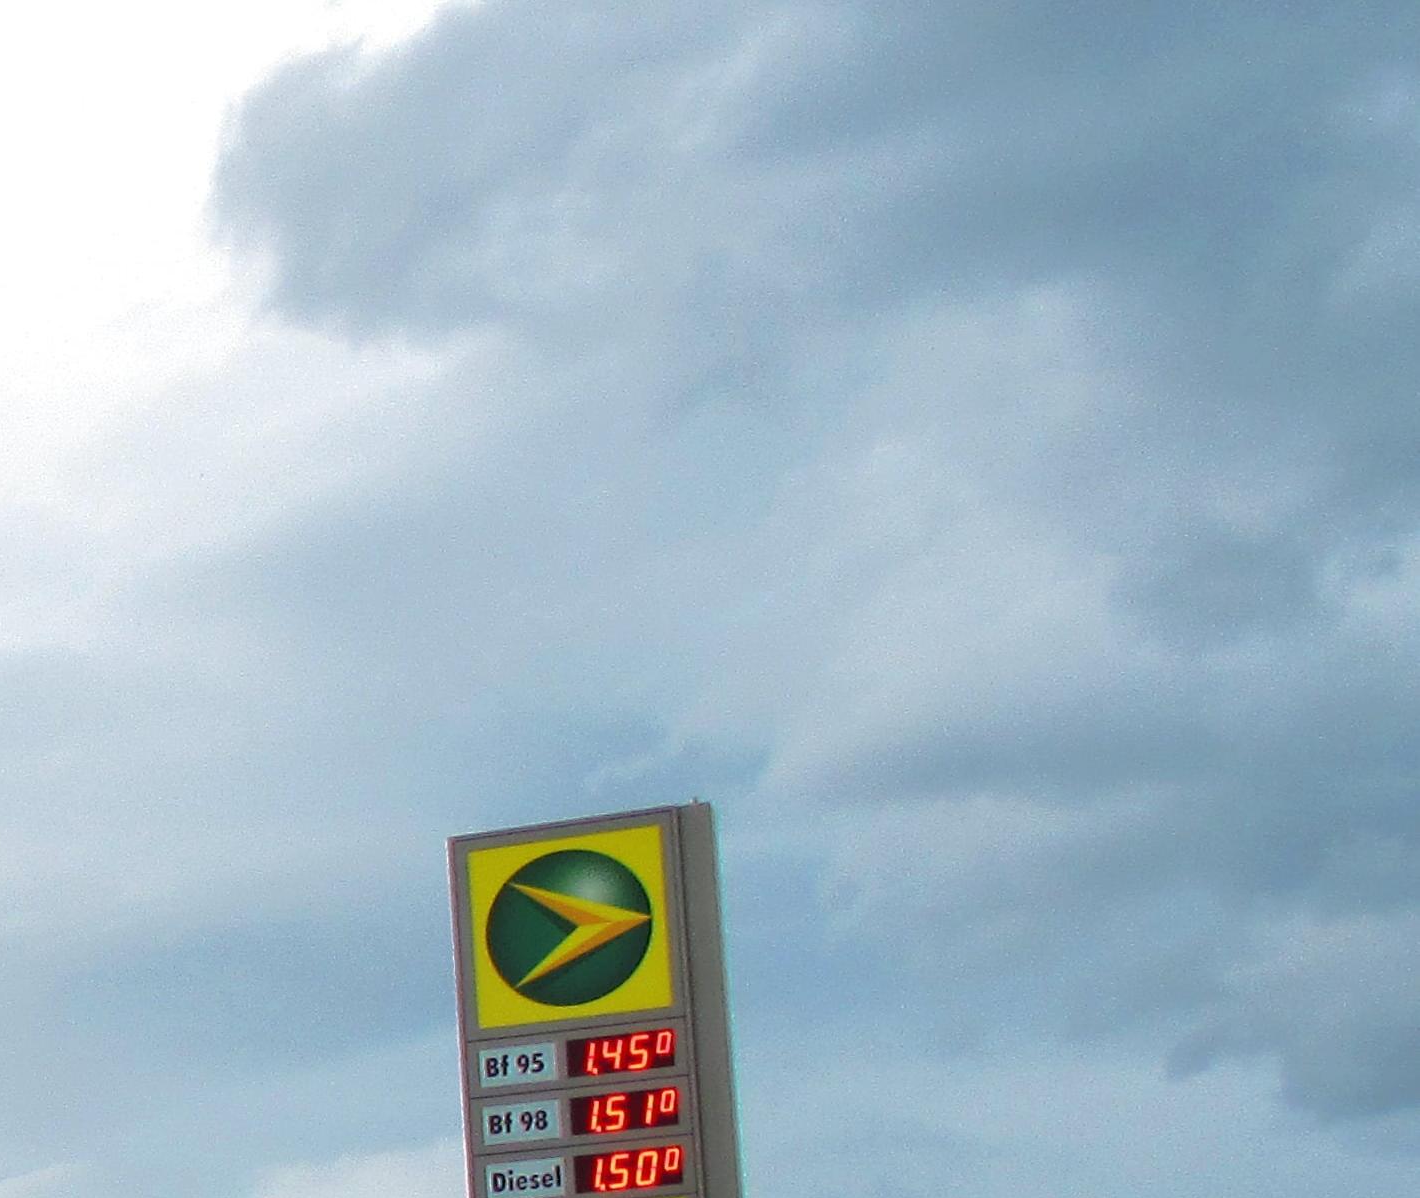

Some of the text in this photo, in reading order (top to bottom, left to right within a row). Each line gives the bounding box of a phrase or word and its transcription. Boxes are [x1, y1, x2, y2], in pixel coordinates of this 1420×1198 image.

[486, 1054, 509, 1077] Bf
[516, 1053, 545, 1073] 95
[489, 1111, 512, 1134] Bf
[520, 1110, 548, 1131] 98
[492, 1165, 562, 1192] Diesel
